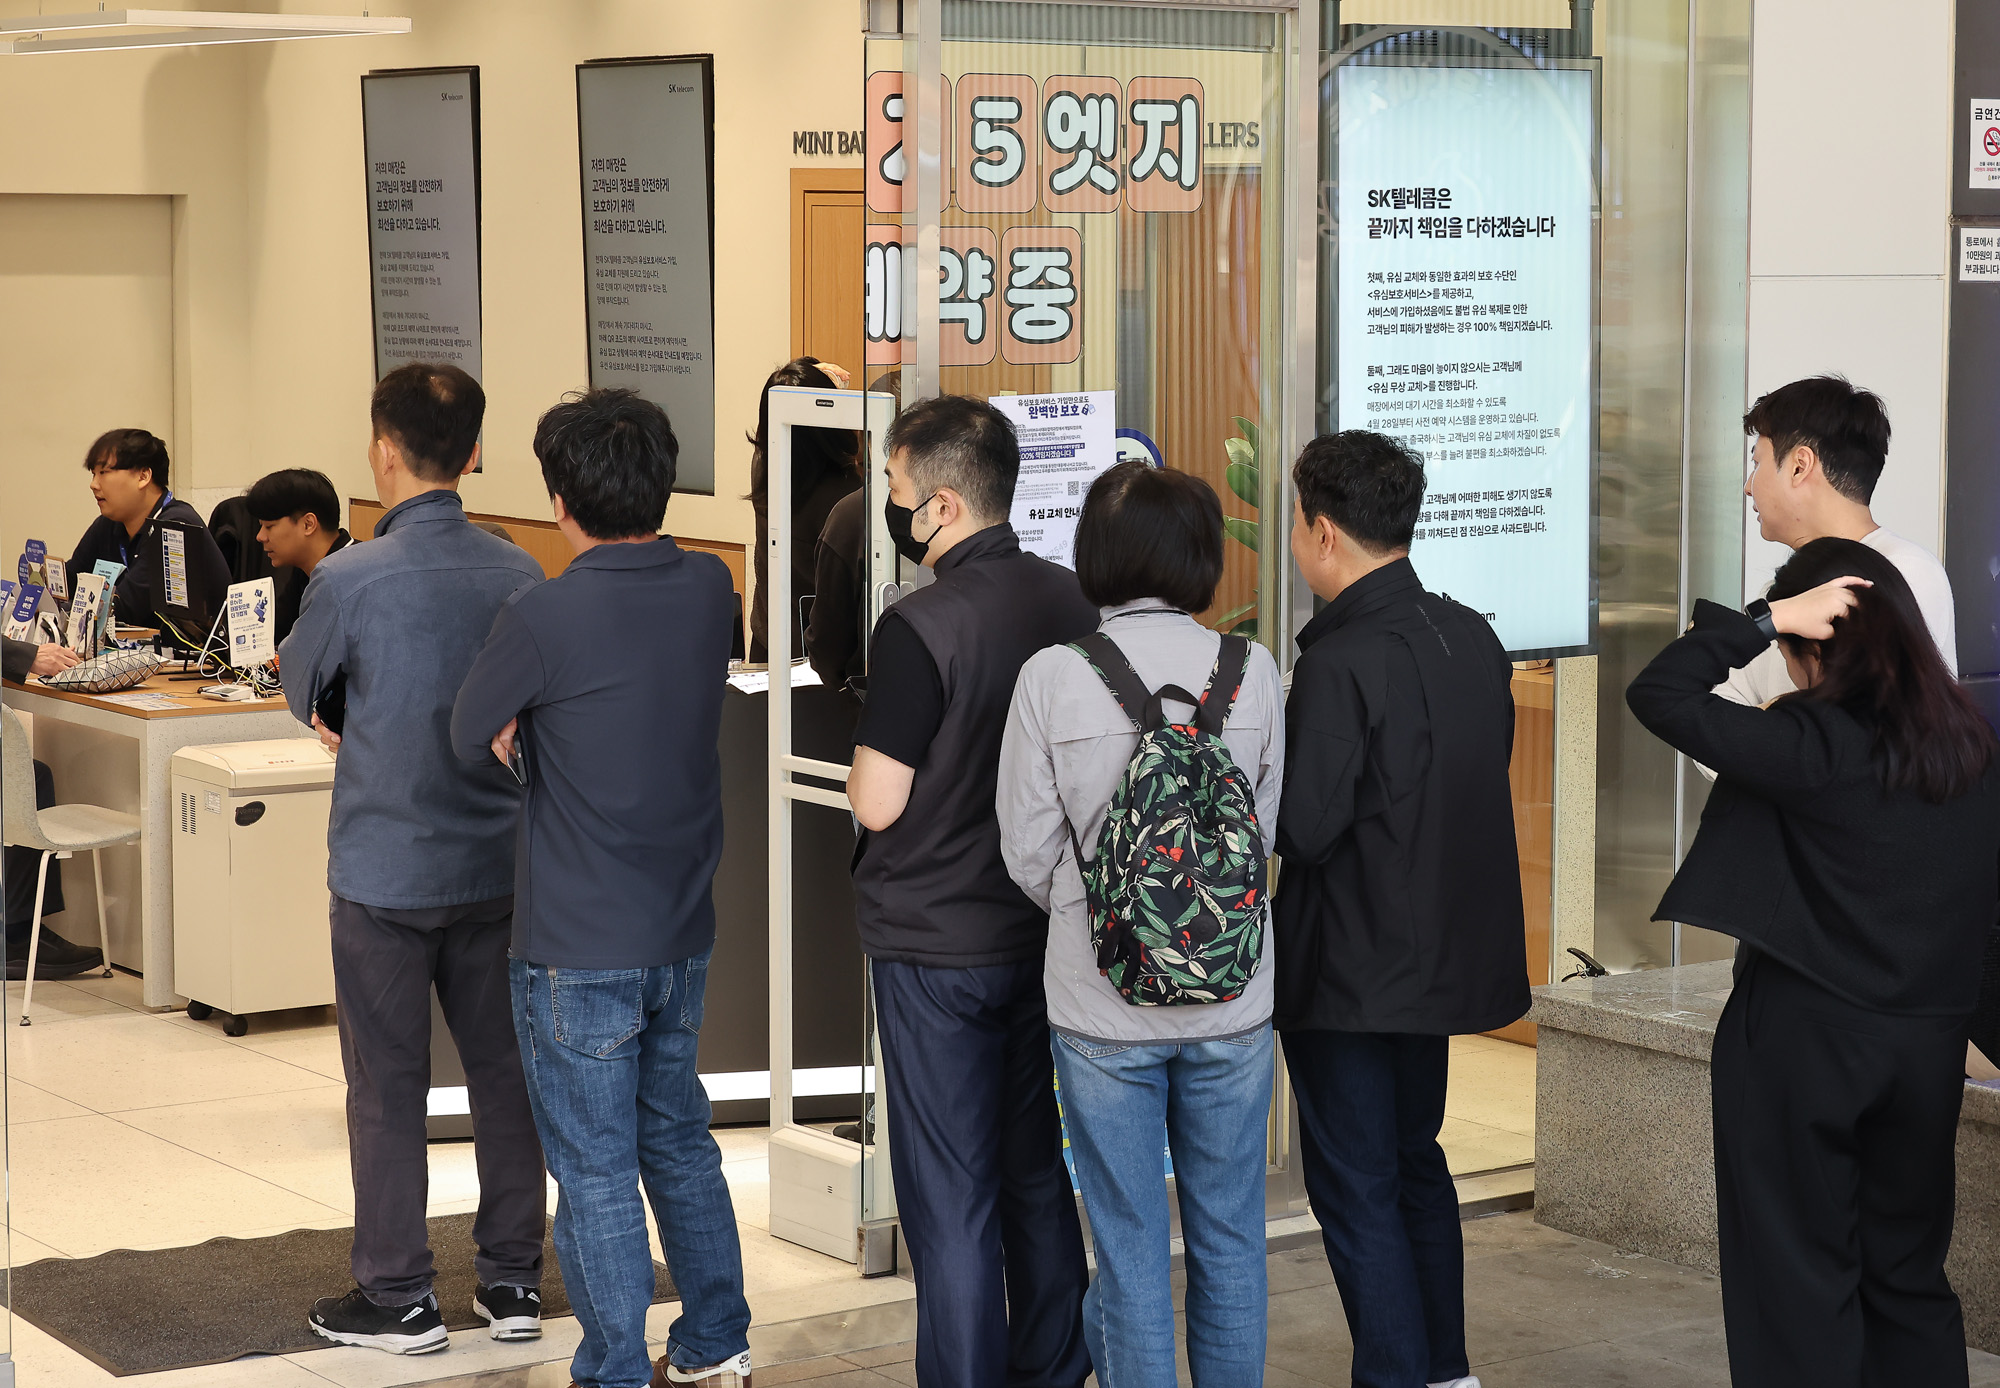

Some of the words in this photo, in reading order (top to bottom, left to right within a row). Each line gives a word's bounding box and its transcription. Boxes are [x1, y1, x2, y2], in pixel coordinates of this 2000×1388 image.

[669, 84, 676, 93] SK
[441, 93, 449, 101] SK
[793, 131, 833, 154] MINI
[375, 162, 387, 174] 저희
[388, 161, 406, 175] 매장은
[591, 158, 604, 172] 저희
[606, 158, 627, 172] 매장은
[376, 180, 399, 193] 고객님의
[400, 180, 417, 193] 정보를
[419, 179, 442, 193] 안전하게
[592, 179, 618, 193] 고객님의
[620, 178, 640, 193] 정보를
[642, 178, 669, 192] 안전하게
[377, 199, 400, 212] 보호하기
[401, 199, 413, 212] 위해
[1368, 188, 1452, 209] SK텔레콤은
[593, 199, 619, 213] 보호하기
[621, 199, 635, 213] 위해
[378, 218, 395, 231] 최선을
[396, 218, 414, 230] 다하고
[415, 218, 440, 231] 있습니다.
[594, 219, 614, 233] 최선을
[615, 219, 636, 233] 다하고
[637, 219, 666, 233] 있습니다.
[1368, 217, 1412, 239] 끝까지
[1418, 217, 1463, 238] 책임을
[1467, 216, 1556, 238] 다하겠습니다
[1966, 237, 1993, 247] 통로에서
[1966, 251, 1992, 260] 10만원의
[1965, 264, 1999, 274] 부과됩니다
[1368, 272, 1385, 284] 첫째,
[1387, 272, 1401, 283] 유심
[1404, 271, 1427, 282] 교체와
[1429, 271, 1451, 282] 동일한
[1453, 271, 1475, 281] 효과의
[1478, 271, 1493, 280] 보호
[1494, 270, 1516, 281] 수단인
[1368, 288, 1440, 300] <유심보호서비스>를
[1442, 288, 1474, 300] 제공하고,
[1367, 307, 1398, 318] 서비스에
[1400, 306, 1453, 317] 가입하셨음에도
[1455, 305, 1469, 316] 불법
[1472, 305, 1486, 315] 유심
[1489, 304, 1511, 315] 복제로
[1513, 304, 1527, 314] 인한
[1367, 324, 1398, 335] 고객님의
[1400, 323, 1423, 334] 피해가
[1425, 322, 1455, 334] 발생하는
[1457, 322, 1472, 333] 경우
[1474, 322, 1497, 331] 100%
[1499, 320, 1552, 331] 책임지겠습니다.
[1367, 365, 1384, 377] 둘째,
[1387, 365, 1409, 375] 그래도
[1412, 364, 1434, 375] 마음이
[1436, 363, 1458, 374] 놓이지
[1461, 362, 1490, 373] 않으시는
[1492, 361, 1522, 372] 고객님께
[1368, 382, 1388, 393] <유심
[1390, 382, 1405, 393] 무상
[1407, 381, 1436, 392] 교체>를
[1438, 379, 1477, 391] 진행합니다.
[1018, 398, 1057, 407] 유심보호서비스
[1056, 396, 1089, 406] 가입만으로도
[1367, 401, 1403, 412] 매장에서의
[1406, 400, 1420, 410] 대기
[1422, 399, 1444, 410] 시간을
[1446, 398, 1474, 409] 최소화할
[1476, 398, 1483, 408] 수
[1485, 397, 1506, 407] 있도록
[1028, 405, 1058, 419] 완벽한
[1060, 404, 1079, 416] 보호
[1367, 418, 1380, 430] 4월
[1382, 418, 1413, 428] 28일부터
[1415, 417, 1429, 427] 사전
[1432, 416, 1446, 426] 예약
[1448, 415, 1476, 426] 시스템을
[1479, 414, 1507, 425] 운영하고
[1509, 413, 1538, 423] 있습니다.
[1410, 434, 1445, 445] 출국하시는
[1448, 432, 1476, 442] 고객님의
[1478, 431, 1492, 441] 유심
[1494, 430, 1515, 440] 교체에
[1517, 429, 1538, 439] 차질이
[1540, 428, 1560, 439] 없도록
[1426, 450, 1447, 461] 부스를
[1449, 449, 1463, 460] 늘려
[1466, 448, 1487, 459] 불편을
[1489, 446, 1546, 458] 최소화하겠습니다.
[1426, 493, 1456, 504] 고객님께
[1458, 492, 1481, 503] 어떠한
[1482, 491, 1505, 502] 피해도
[1506, 489, 1528, 501] 생기지
[1530, 488, 1552, 499] 않도록
[1029, 509, 1045, 519] 유심
[1047, 508, 1062, 518] 교체
[1064, 507, 1081, 519] 안내
[1434, 510, 1448, 521] 다해
[1450, 509, 1472, 521] 끝까지
[1475, 508, 1497, 519] 책임을
[1499, 505, 1545, 517] 다하겠습니다.
[1428, 527, 1458, 538] 끼쳐드린
[1460, 526, 1467, 537] 점
[1469, 525, 1499, 536] 진심으로
[1501, 522, 1546, 534] 사과드립니다.
